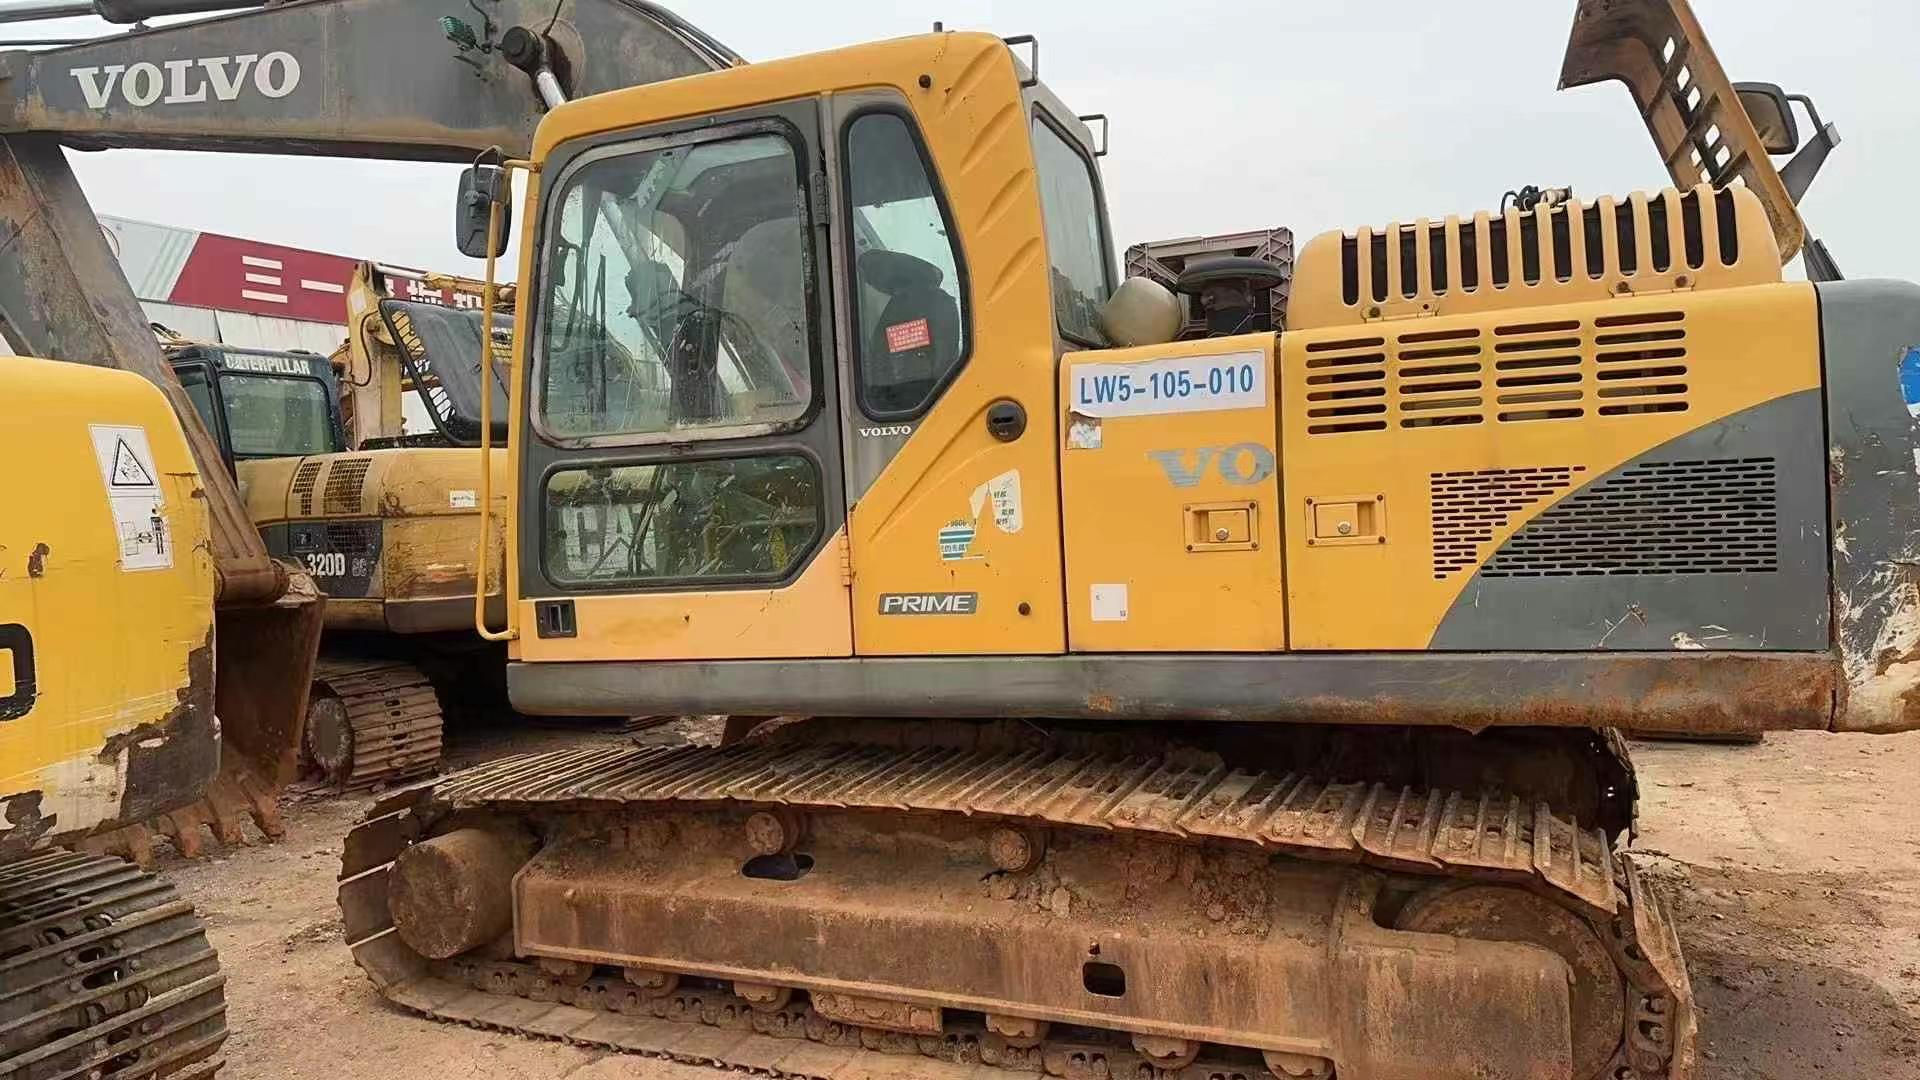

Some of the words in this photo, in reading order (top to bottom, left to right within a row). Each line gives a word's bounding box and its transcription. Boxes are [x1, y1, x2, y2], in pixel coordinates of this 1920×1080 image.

[70, 51, 301, 109] VOLVO
[224, 352, 311, 376] CATERPILLAR
[1079, 364, 1255, 406] LW5-105-010
[858, 425, 912, 437] VOLVO
[306, 552, 346, 578] 320D
[883, 594, 972, 613] PRIME
